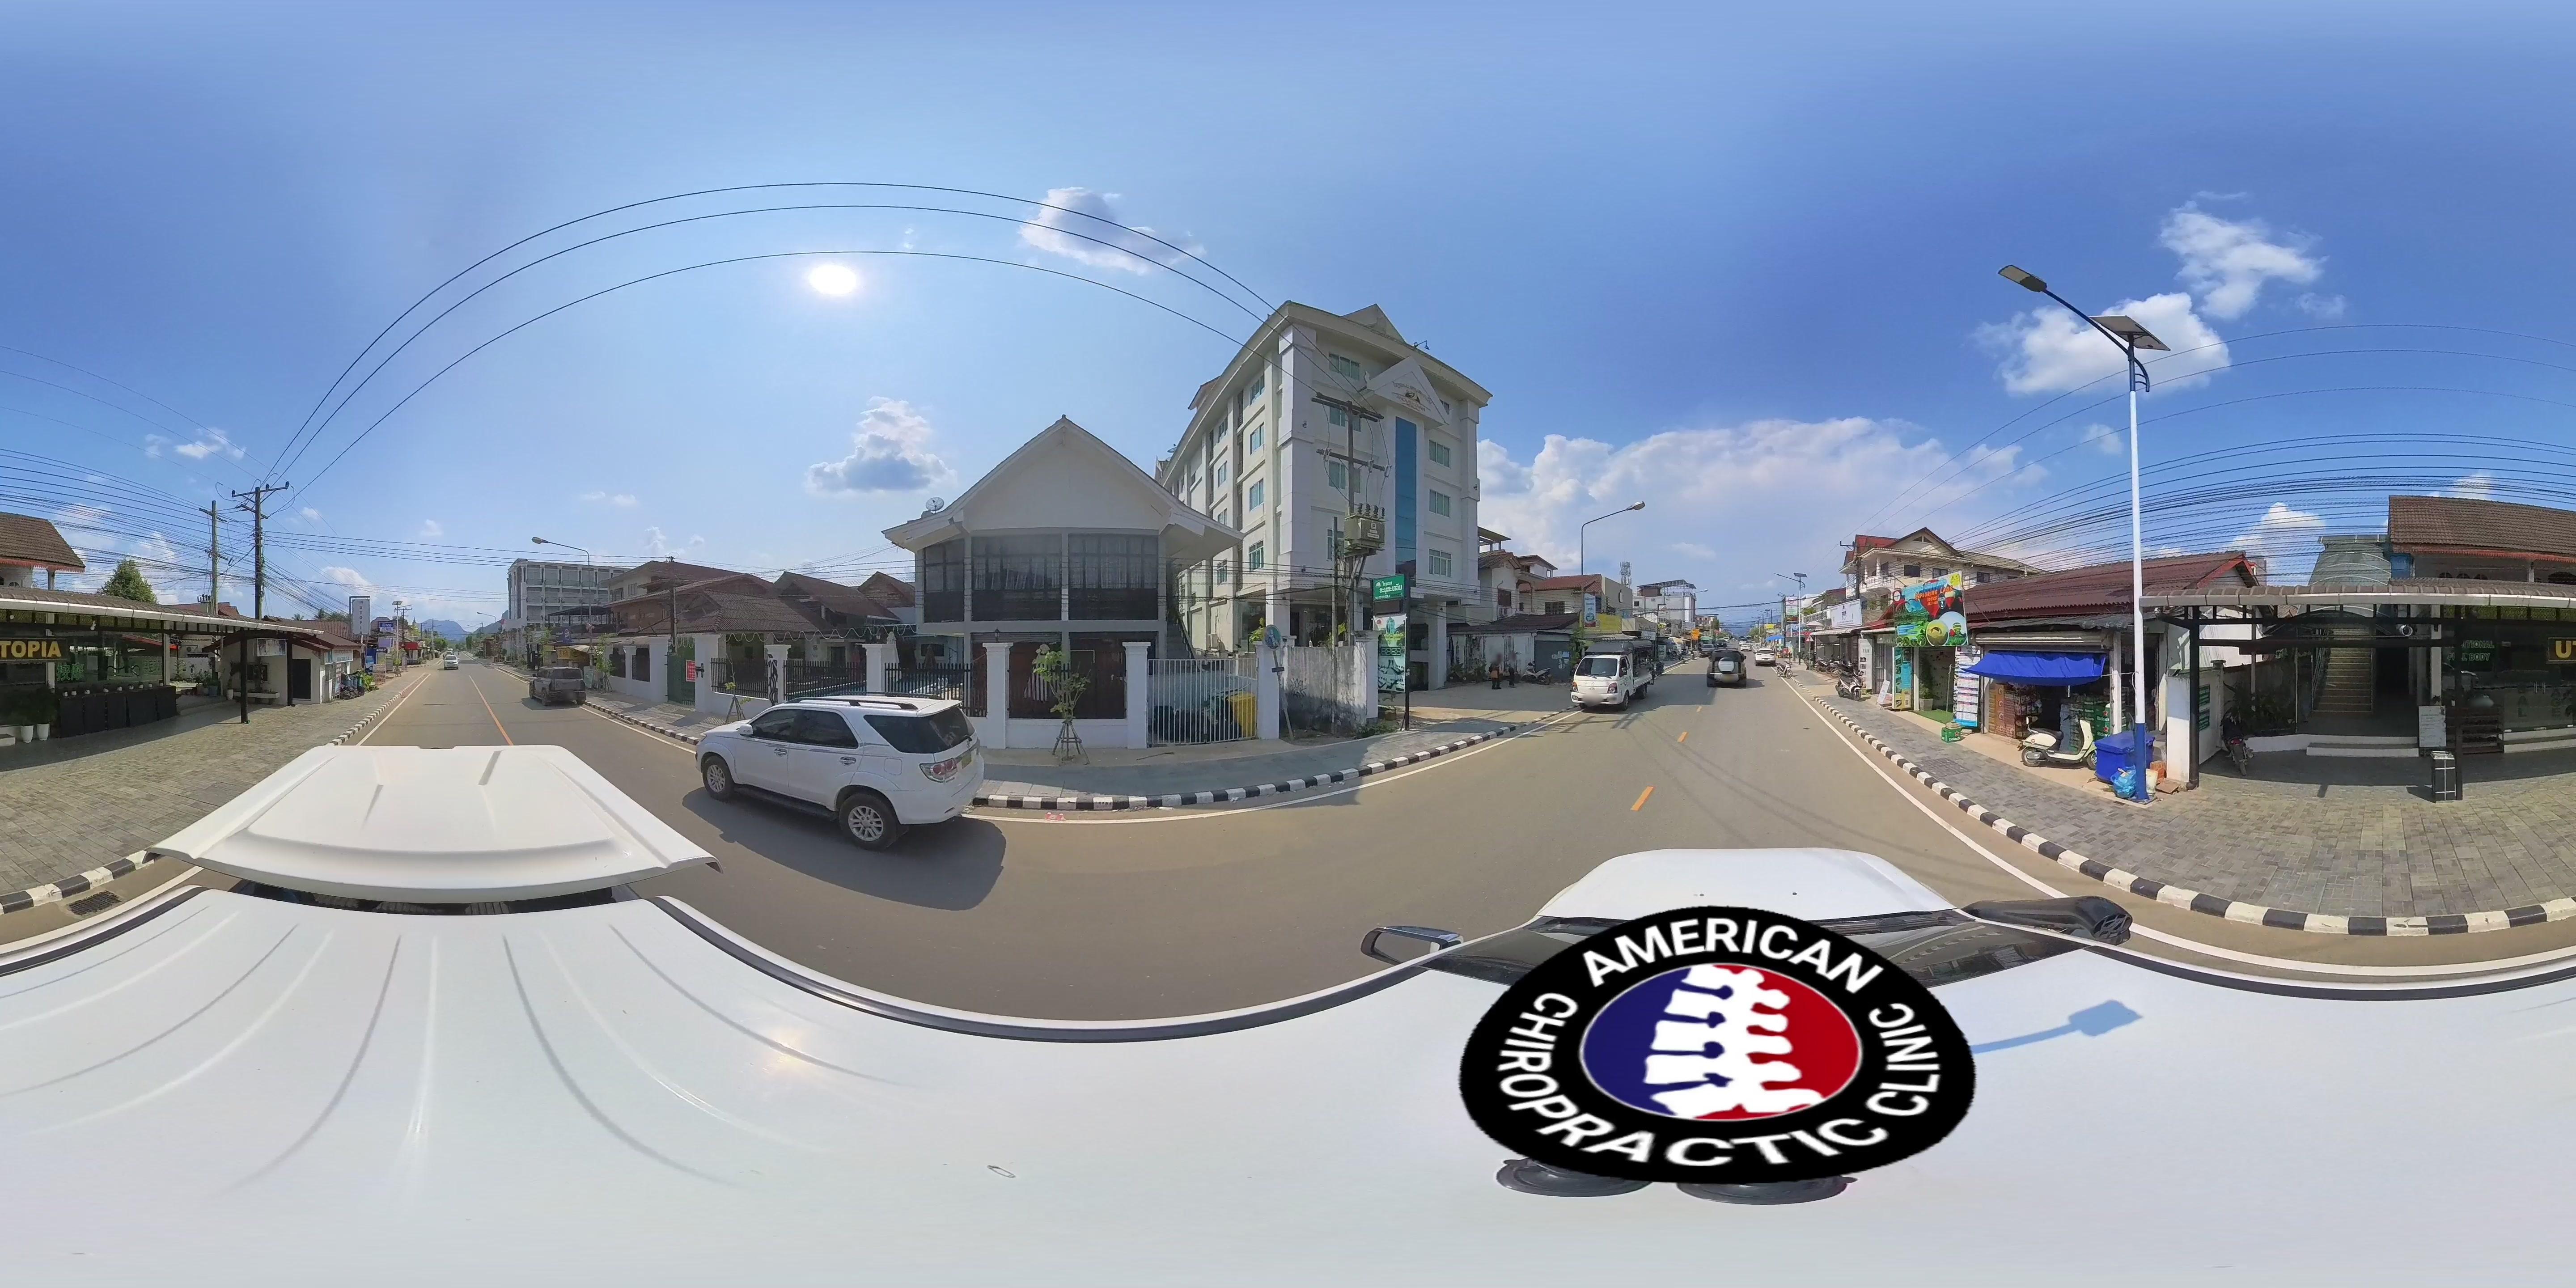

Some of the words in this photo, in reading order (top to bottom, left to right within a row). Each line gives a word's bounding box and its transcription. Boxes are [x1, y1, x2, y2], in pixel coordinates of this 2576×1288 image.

[1940, 585, 1953, 594] LAOS
[0, 641, 61, 657] TOPIA
[2468, 652, 2491, 661] BODY
[2555, 640, 2576, 658] U
[57, 663, 84, 681] 按摩
